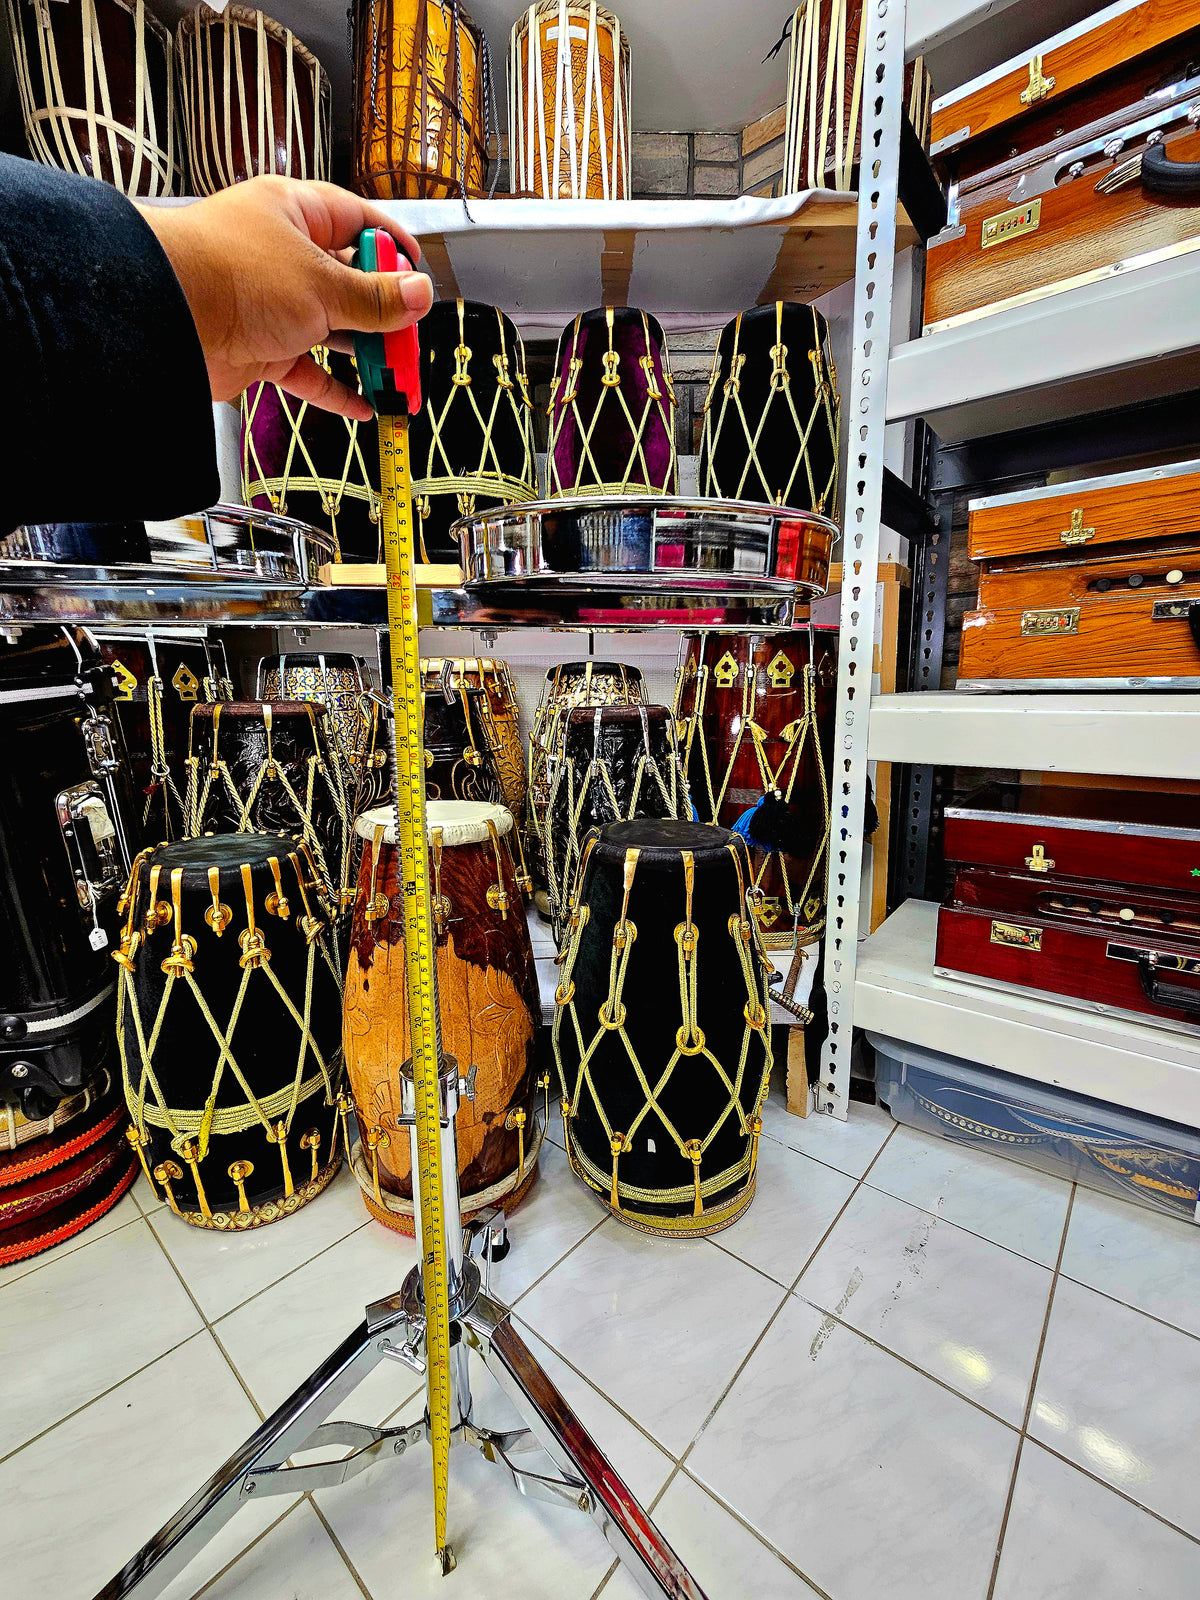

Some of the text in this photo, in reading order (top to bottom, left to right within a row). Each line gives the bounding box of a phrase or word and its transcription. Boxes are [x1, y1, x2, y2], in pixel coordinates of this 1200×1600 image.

[395, 422, 402, 438] 90
[384, 441, 393, 456] 35
[387, 487, 395, 501] 34
[389, 531, 397, 545] 33
[393, 575, 400, 587] 32
[402, 595, 410, 609] 80
[394, 617, 401, 629] 31
[396, 658, 404, 670] 30
[398, 697, 406, 709] 29
[400, 736, 407, 748] 28
[410, 753, 418, 766] 70
[402, 774, 409, 786] 27
[404, 811, 411, 823] 26
[406, 847, 413, 859] 25
[408, 883, 415, 894] 2F
[416, 895, 424, 907] 60
[409, 918, 416, 929] 23
[411, 951, 418, 962] 22
[413, 985, 420, 995] 21
[415, 1017, 421, 1028] 20
[423, 1027, 430, 1037] 50
[416, 1049, 423, 1058] 19
[418, 1080, 424, 1089] 18
[421, 1141, 428, 1150] 16
[429, 1146, 436, 1157] 40
[422, 1169, 429, 1178] 15
[424, 1198, 430, 1207] 14
[426, 1226, 432, 1235] 13
